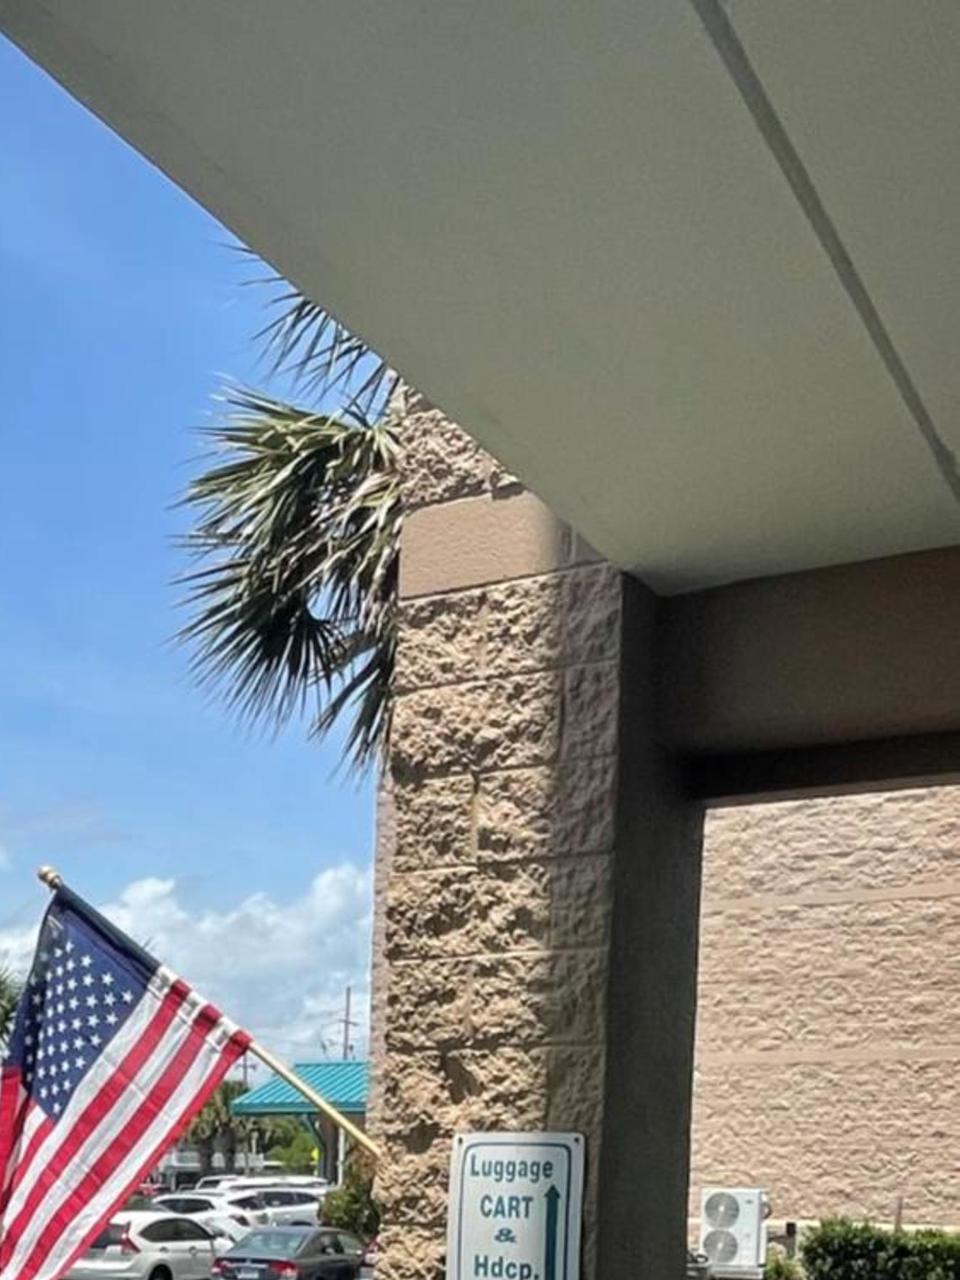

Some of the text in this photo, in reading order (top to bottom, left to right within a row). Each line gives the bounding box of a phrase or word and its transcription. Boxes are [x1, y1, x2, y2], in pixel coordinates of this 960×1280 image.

[470, 1155, 553, 1183] Luggage
[480, 1195, 533, 1219] CART
[494, 1228, 517, 1243] &
